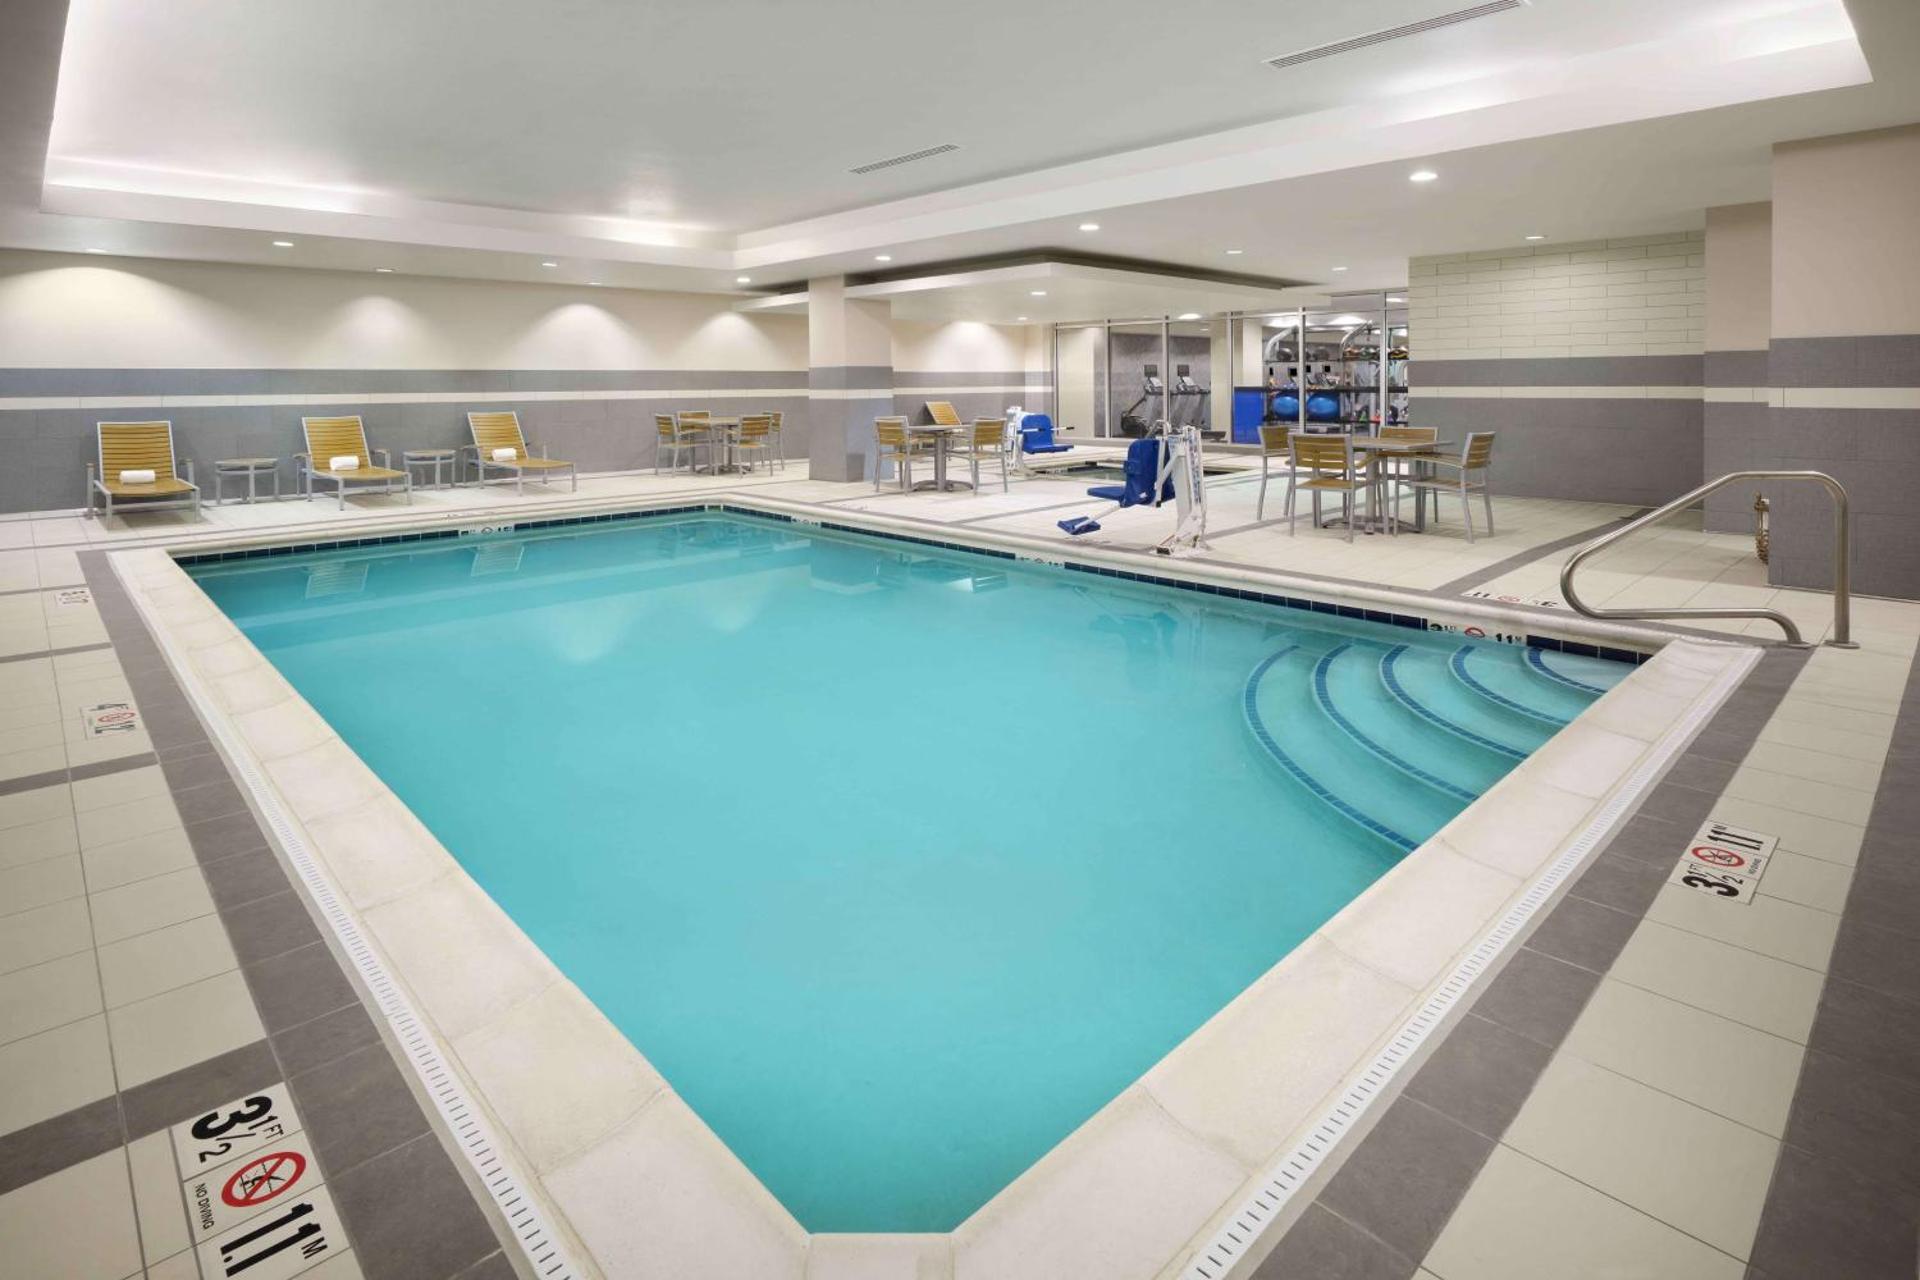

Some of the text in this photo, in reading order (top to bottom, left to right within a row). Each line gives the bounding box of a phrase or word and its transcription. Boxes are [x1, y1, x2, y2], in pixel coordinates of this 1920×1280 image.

[263, 1123, 284, 1139] FT
[195, 1183, 214, 1230] NO DIVING
[220, 1203, 328, 1277] 1.1 M
